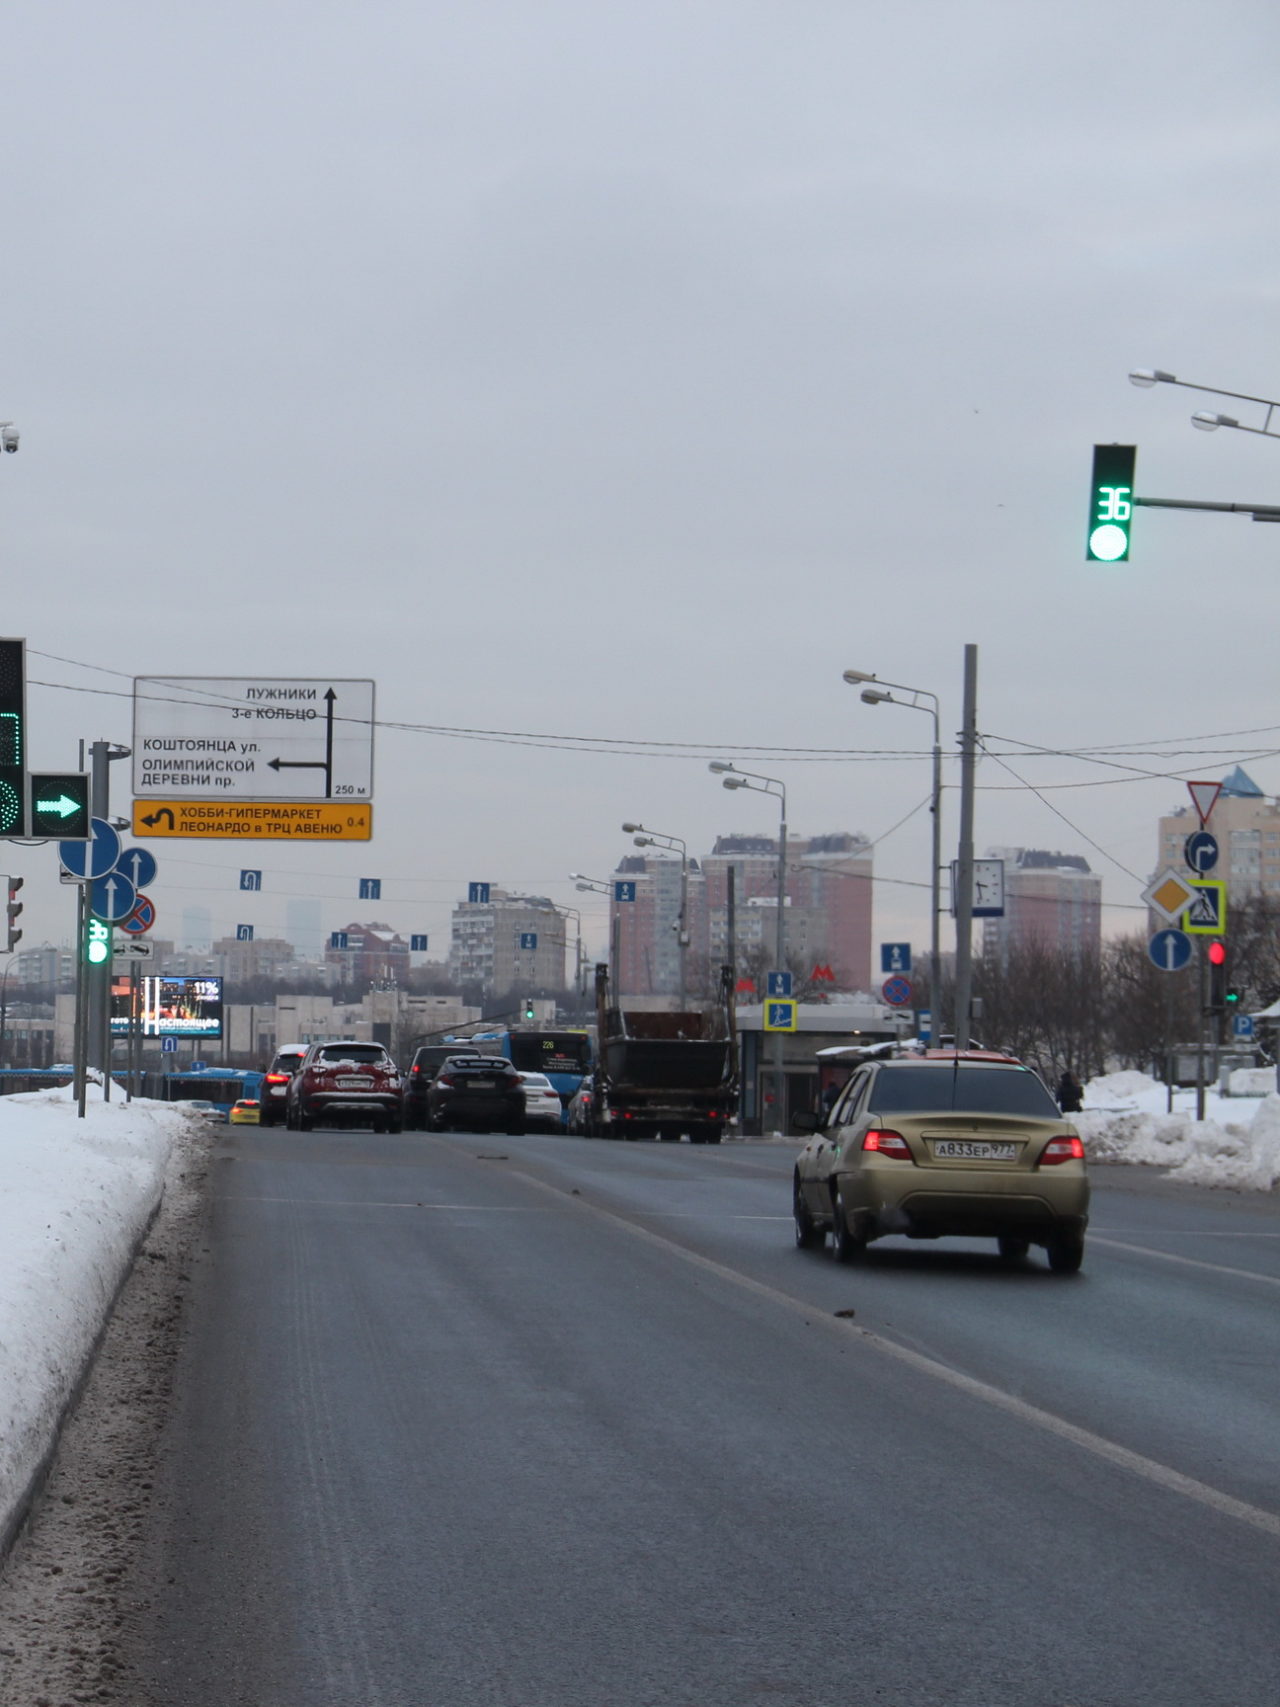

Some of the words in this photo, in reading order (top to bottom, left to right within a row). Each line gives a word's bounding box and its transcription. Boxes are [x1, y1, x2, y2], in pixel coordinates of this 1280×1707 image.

[1097, 487, 1131, 521] 36
[245, 688, 317, 700] ЛУЖНИКИ
[231, 708, 252, 719] 3-е
[256, 709, 317, 721] КОЛЬЦО
[143, 740, 237, 753] КОШТОЯНЦА
[240, 743, 261, 754] ул.
[142, 757, 255, 772] ОЛИМПИЙСКОЙ
[141, 773, 211, 786] ДЕРЕВНИ
[215, 777, 236, 788] пр.
[335, 785, 354, 794] 250
[179, 807, 323, 820] ХОББИ-ГИПЕРМАРКЕТ
[347, 816, 365, 827] 0.4
[179, 822, 252, 833] ЛЕОНАРДО
[254, 825, 262, 833] в
[265, 823, 291, 835] ТРЦ
[294, 823, 343, 834] АВЕНЮ
[194, 981, 219, 994] 11%
